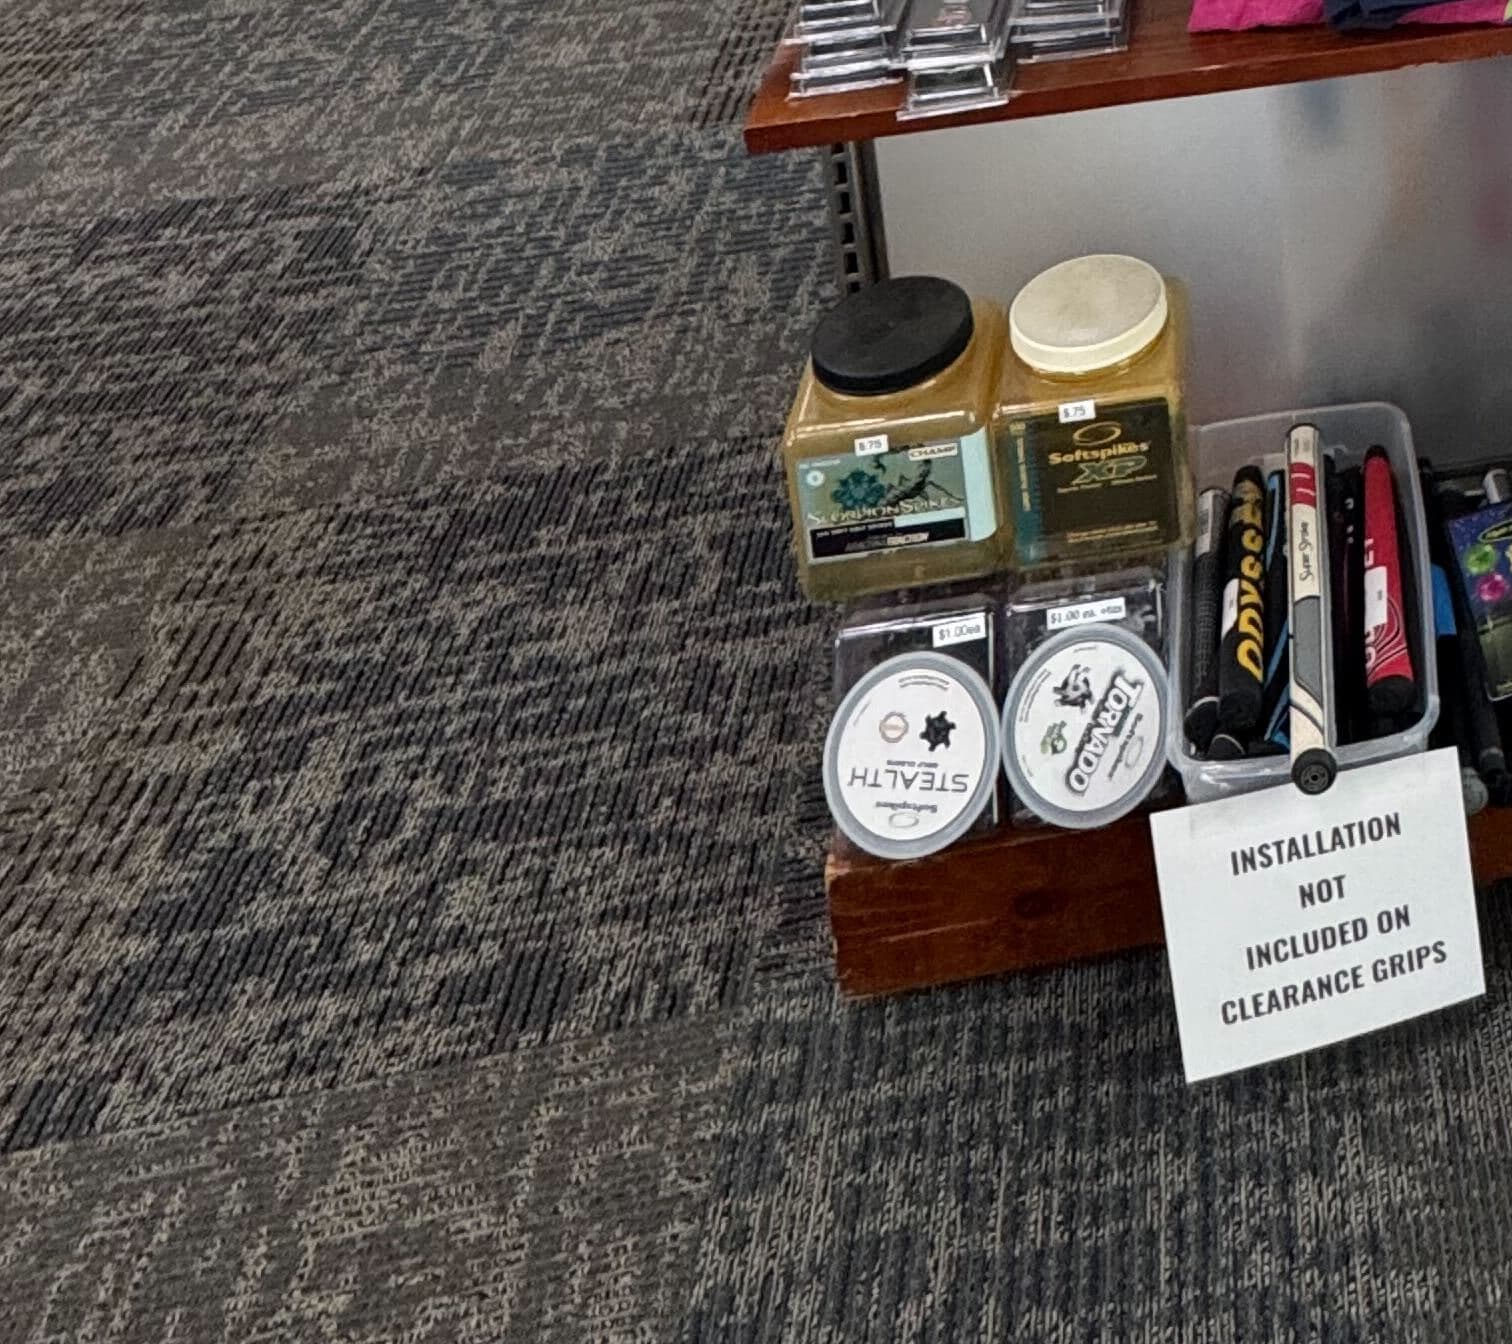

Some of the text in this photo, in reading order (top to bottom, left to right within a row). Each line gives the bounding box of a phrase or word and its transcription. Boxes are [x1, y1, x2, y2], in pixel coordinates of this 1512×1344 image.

[910, 445, 956, 459] CHAMP
[1048, 441, 1151, 465] Softspikes
[1072, 455, 1147, 486] XP
[1066, 672, 1144, 796] TORNADO
[847, 766, 970, 793] STEALTH
[875, 801, 938, 814] Softspikes
[1230, 812, 1401, 876] INSTALLATION
[1299, 874, 1346, 909] NOT
[1246, 904, 1411, 970] INCLUDED ON
[1221, 940, 1447, 1025] CLEARANCE GRIPS
